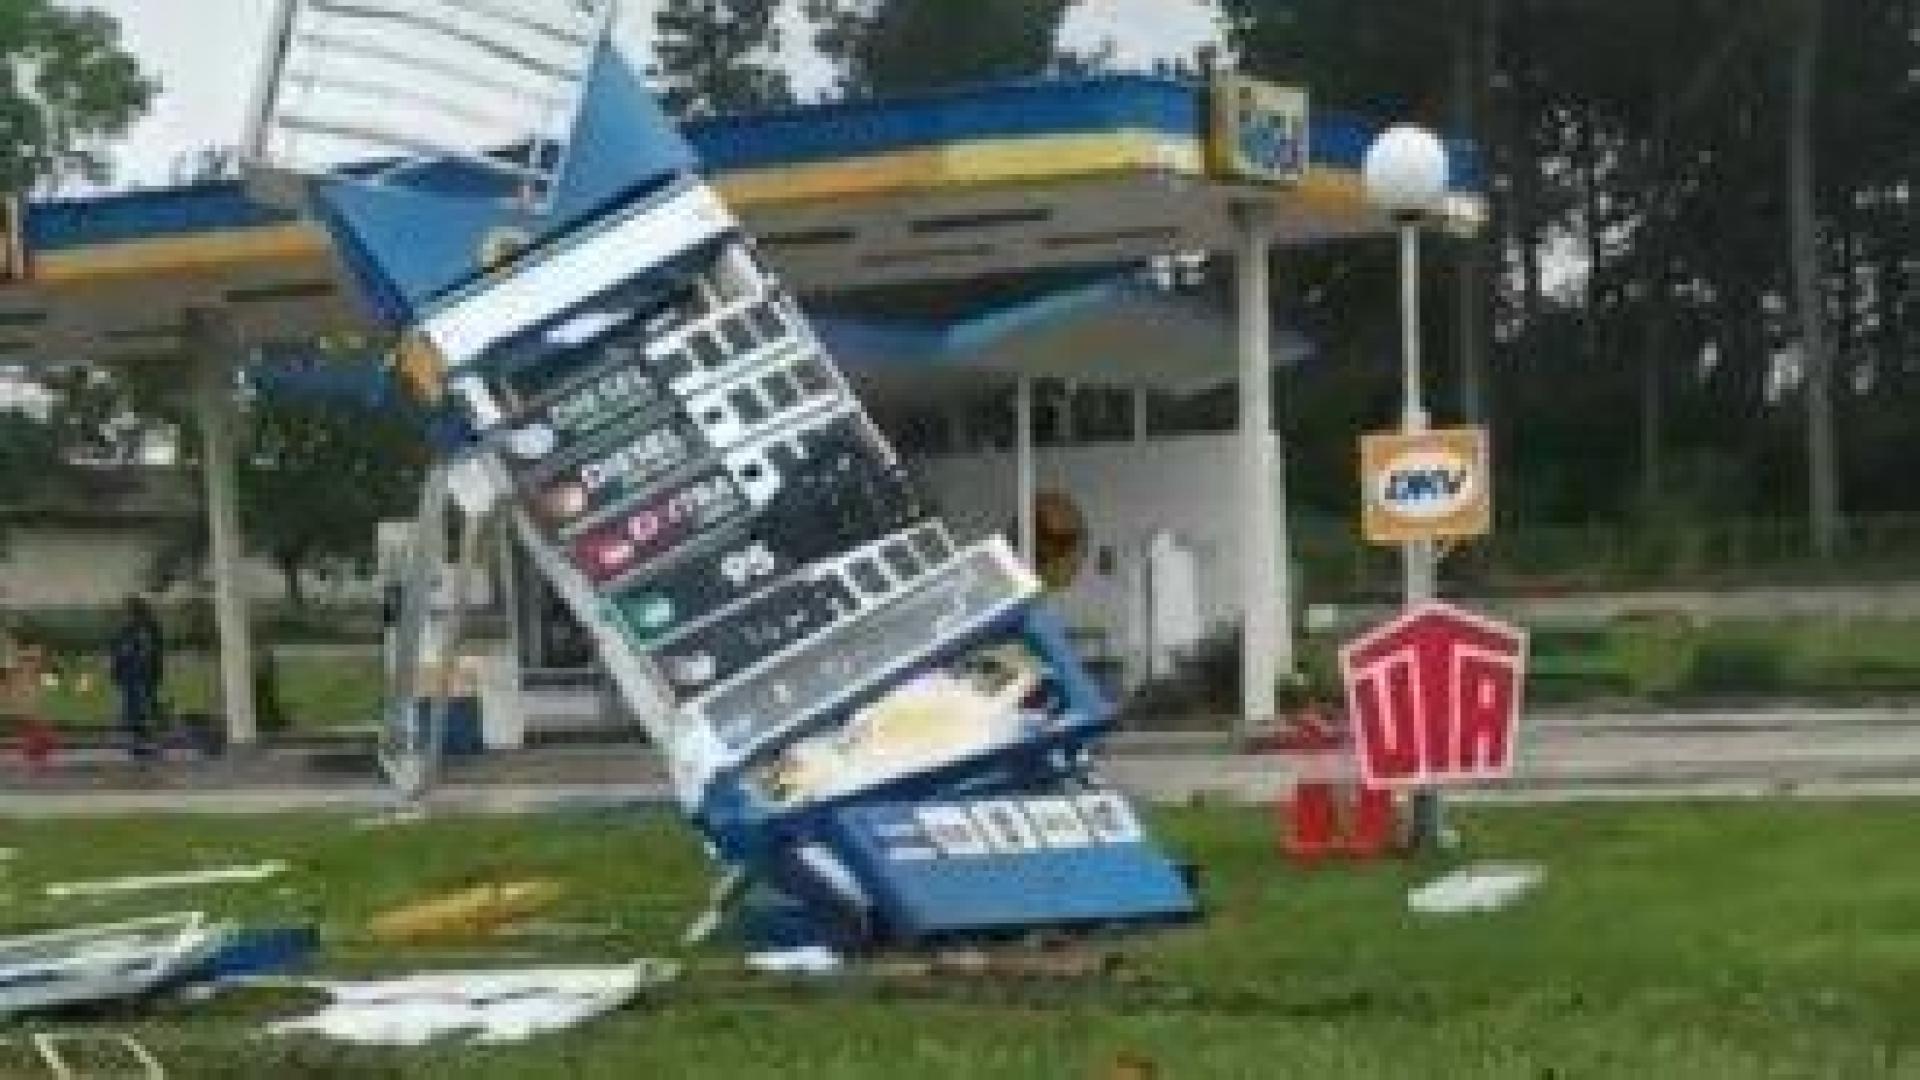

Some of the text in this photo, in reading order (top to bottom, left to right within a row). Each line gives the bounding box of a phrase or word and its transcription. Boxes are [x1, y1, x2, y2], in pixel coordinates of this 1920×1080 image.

[579, 427, 682, 491] DIESEL
[1382, 468, 1469, 501] DKV
[720, 543, 777, 587] 95
[1349, 613, 1520, 779] UTA
